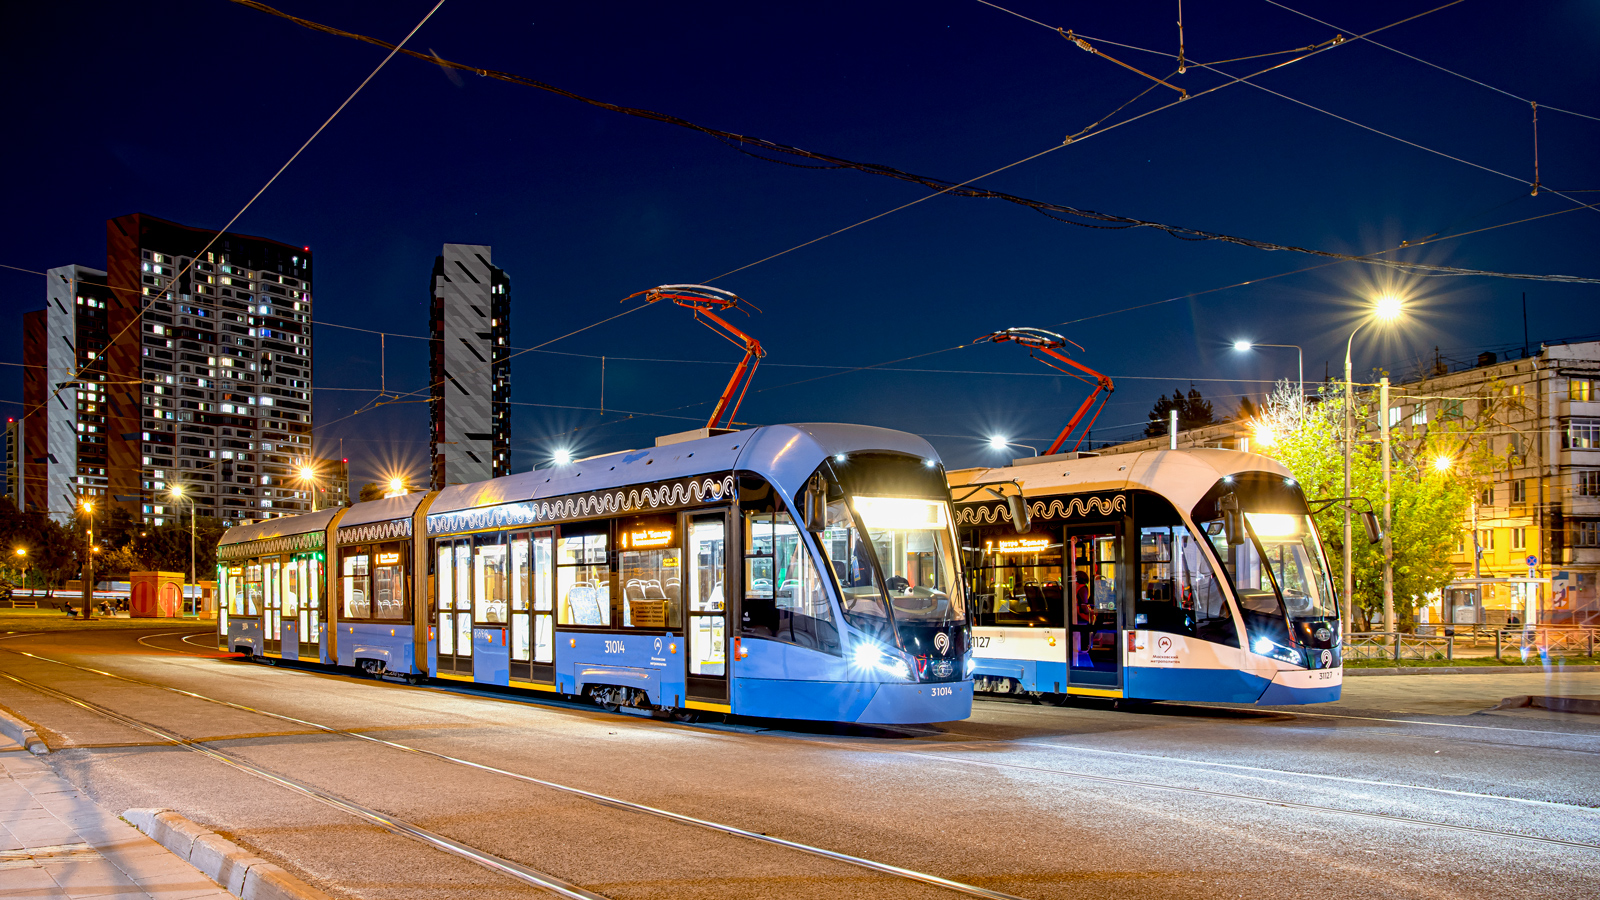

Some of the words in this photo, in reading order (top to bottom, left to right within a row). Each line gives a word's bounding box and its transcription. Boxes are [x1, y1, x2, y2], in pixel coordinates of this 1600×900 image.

[986, 541, 993, 555] 7
[604, 640, 625, 654] 31014
[972, 636, 991, 648] 1127
[1319, 671, 1333, 680] 31127
[931, 686, 953, 697] 31014
